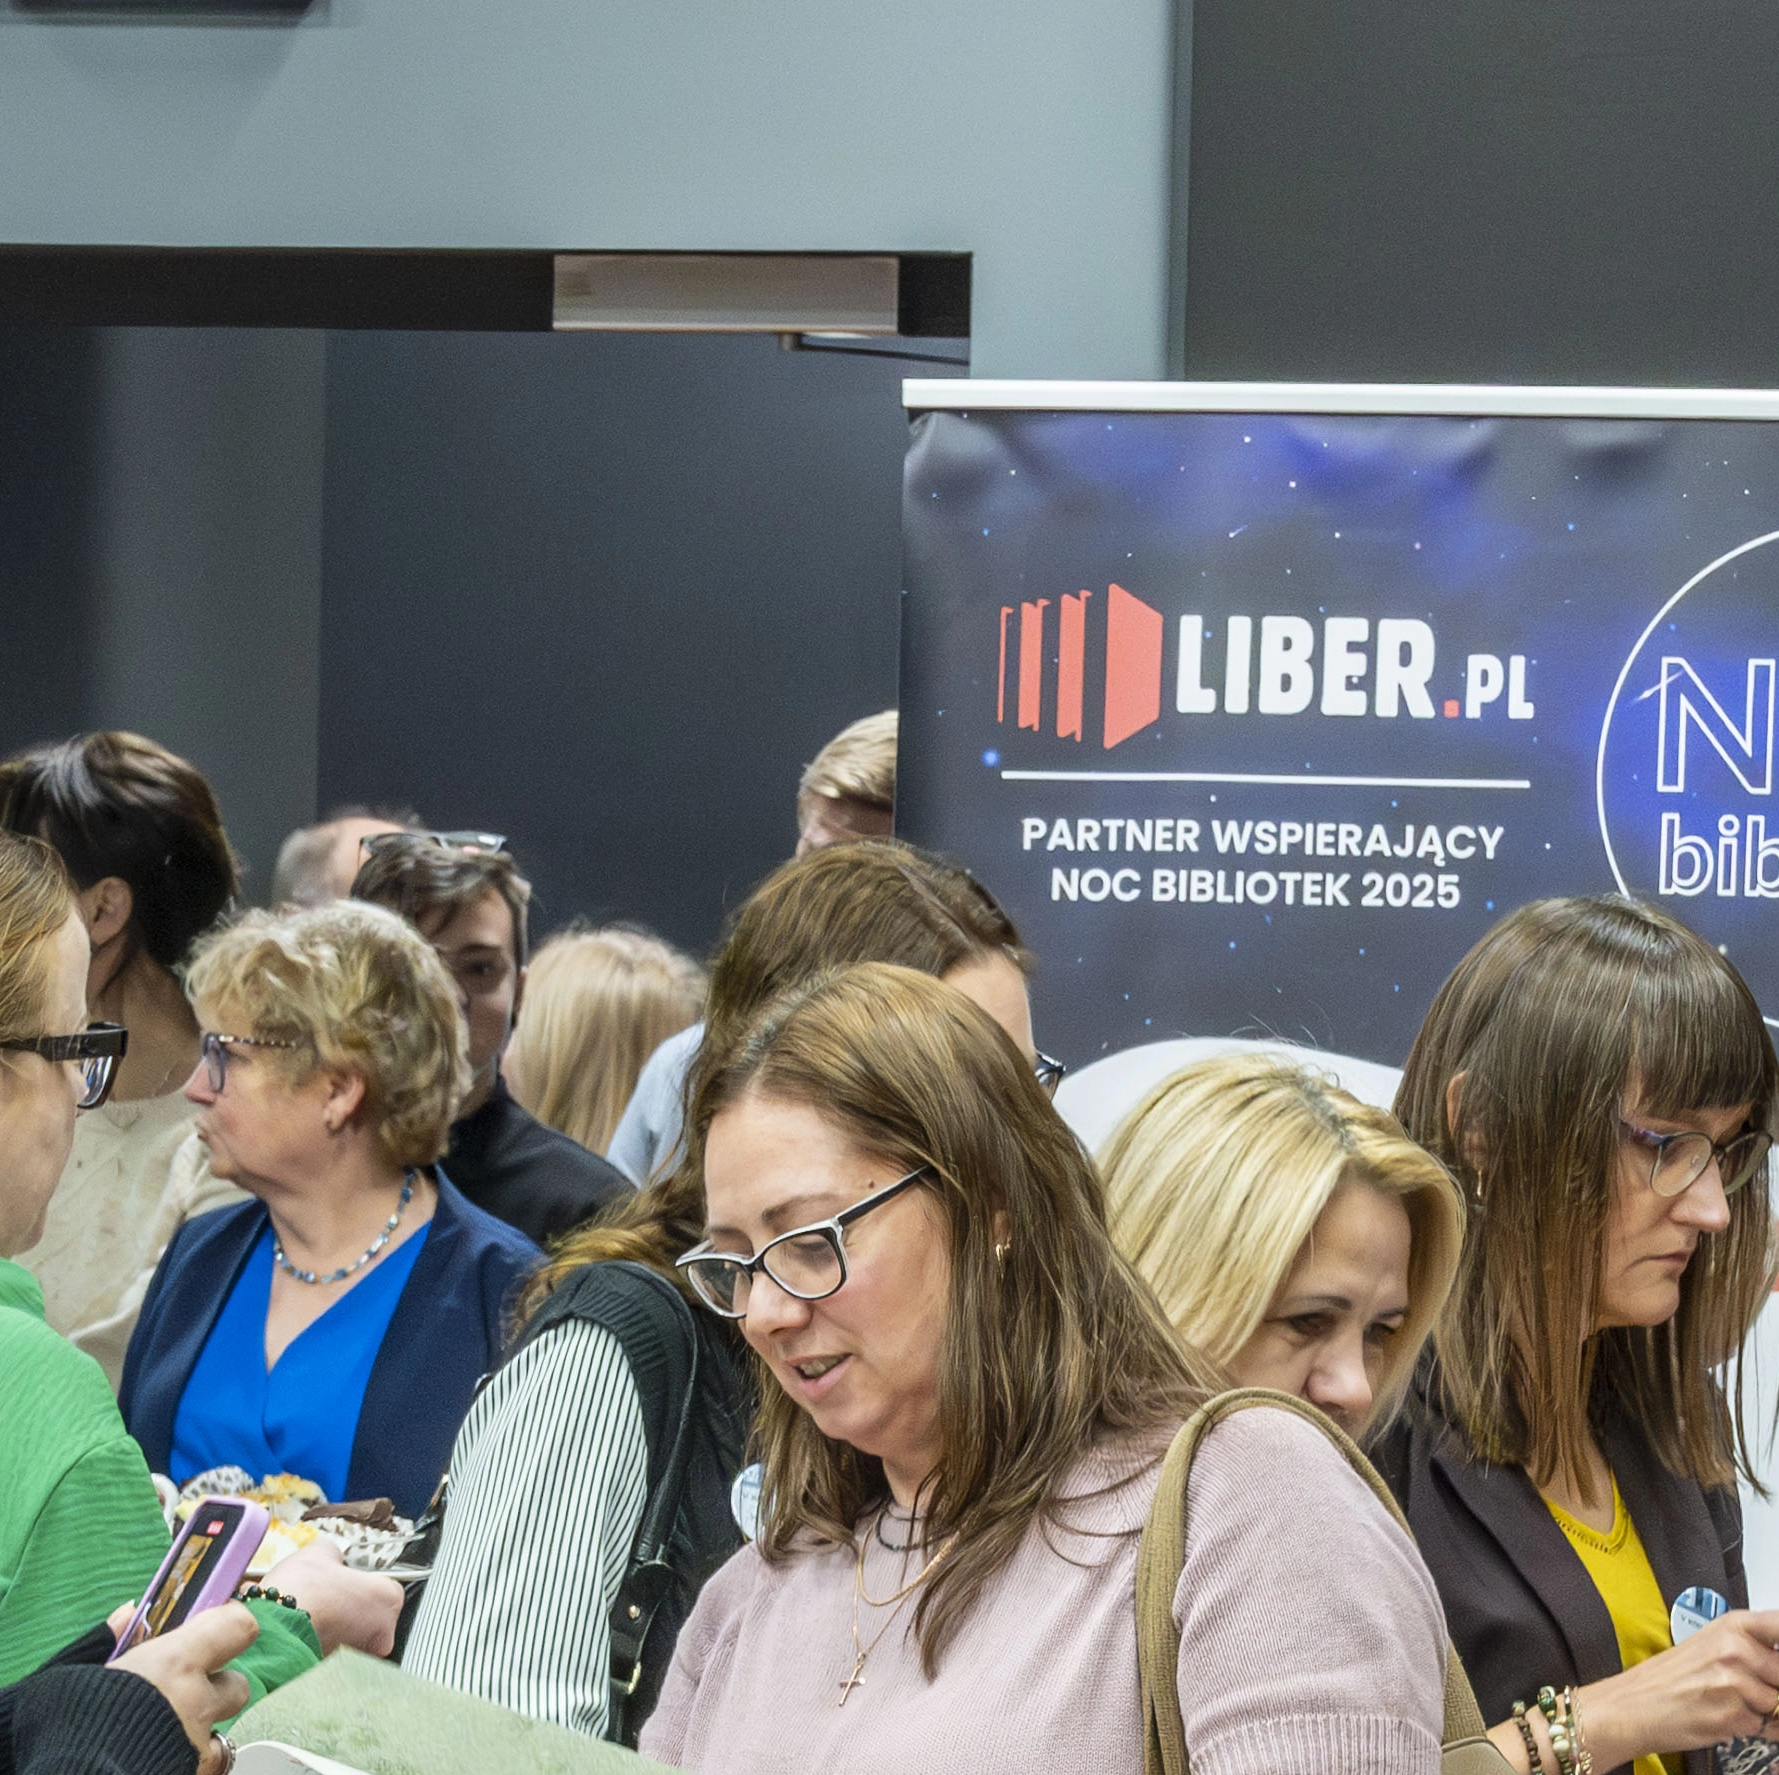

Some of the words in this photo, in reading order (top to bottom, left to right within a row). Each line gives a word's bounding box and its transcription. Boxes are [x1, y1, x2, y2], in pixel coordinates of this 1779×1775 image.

[1176, 615, 1534, 722] LIBER.PL
[1022, 816, 1200, 857] PARTNER
[1210, 820, 1504, 865] WSPIERAJĄCY
[1051, 863, 1140, 902] NOC
[1156, 867, 1351, 908] BIBLIOTEK
[1360, 871, 1462, 910] 2025
